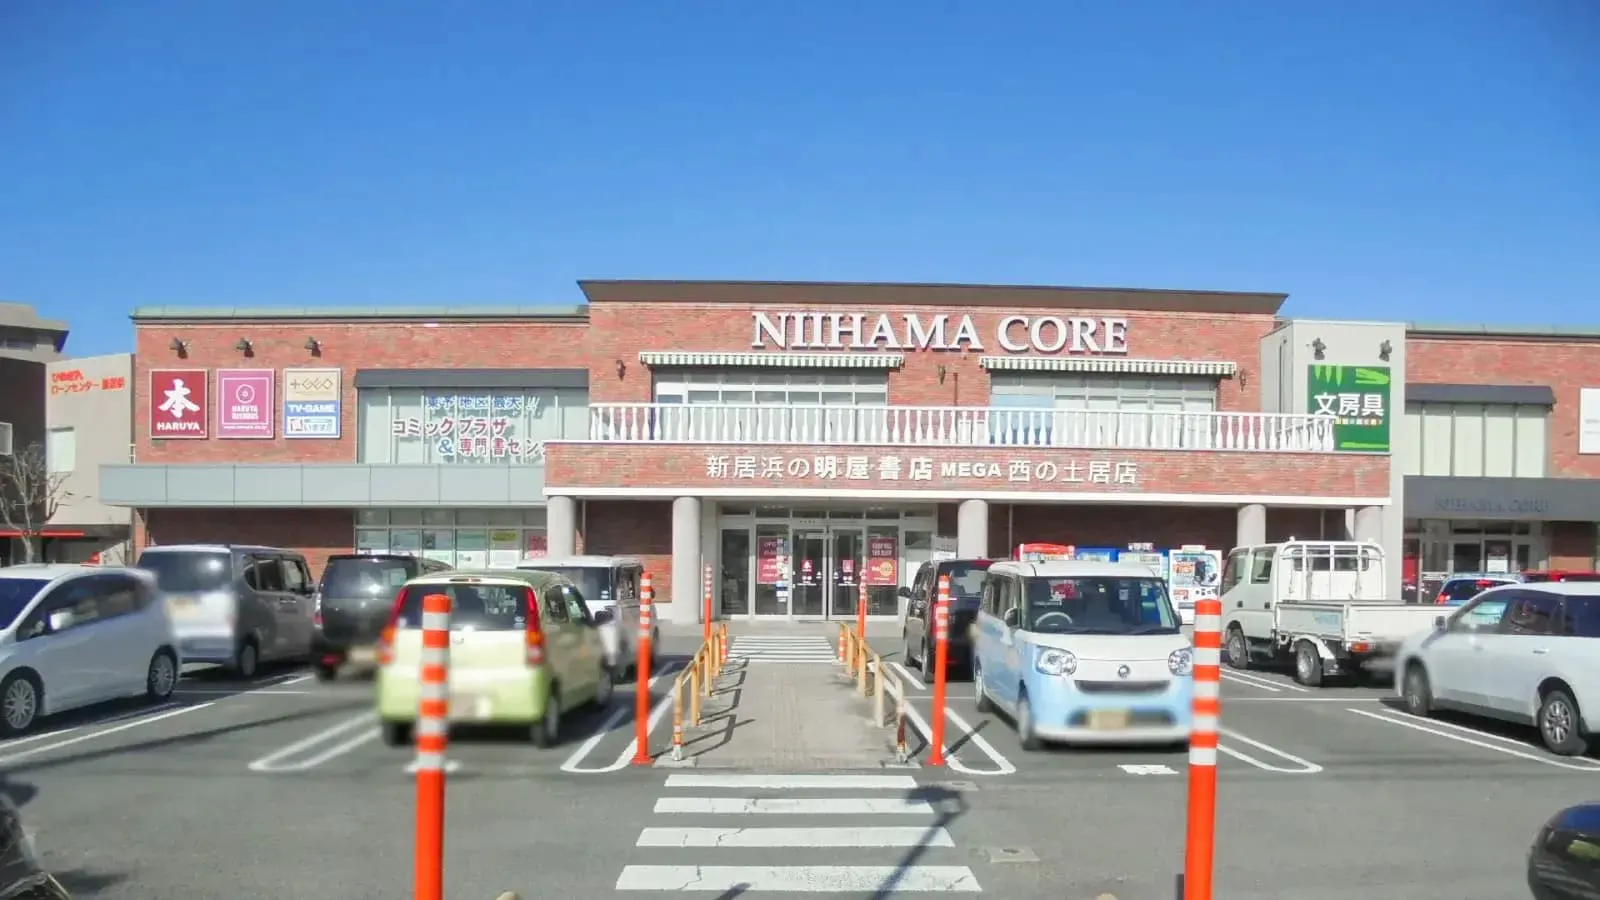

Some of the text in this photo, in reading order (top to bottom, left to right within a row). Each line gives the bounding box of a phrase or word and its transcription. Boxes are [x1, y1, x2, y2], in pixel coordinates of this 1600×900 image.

[752, 311, 1128, 353] NIIHAMA CORE
[158, 378, 200, 418] 本
[288, 404, 336, 413] TV-GAME
[1314, 392, 1384, 416] 文房具
[157, 421, 200, 431] HARUYA
[393, 417, 508, 436] コミックプラザ
[941, 462, 1001, 478] MEGA
[1008, 459, 1138, 484] 西の土居店
